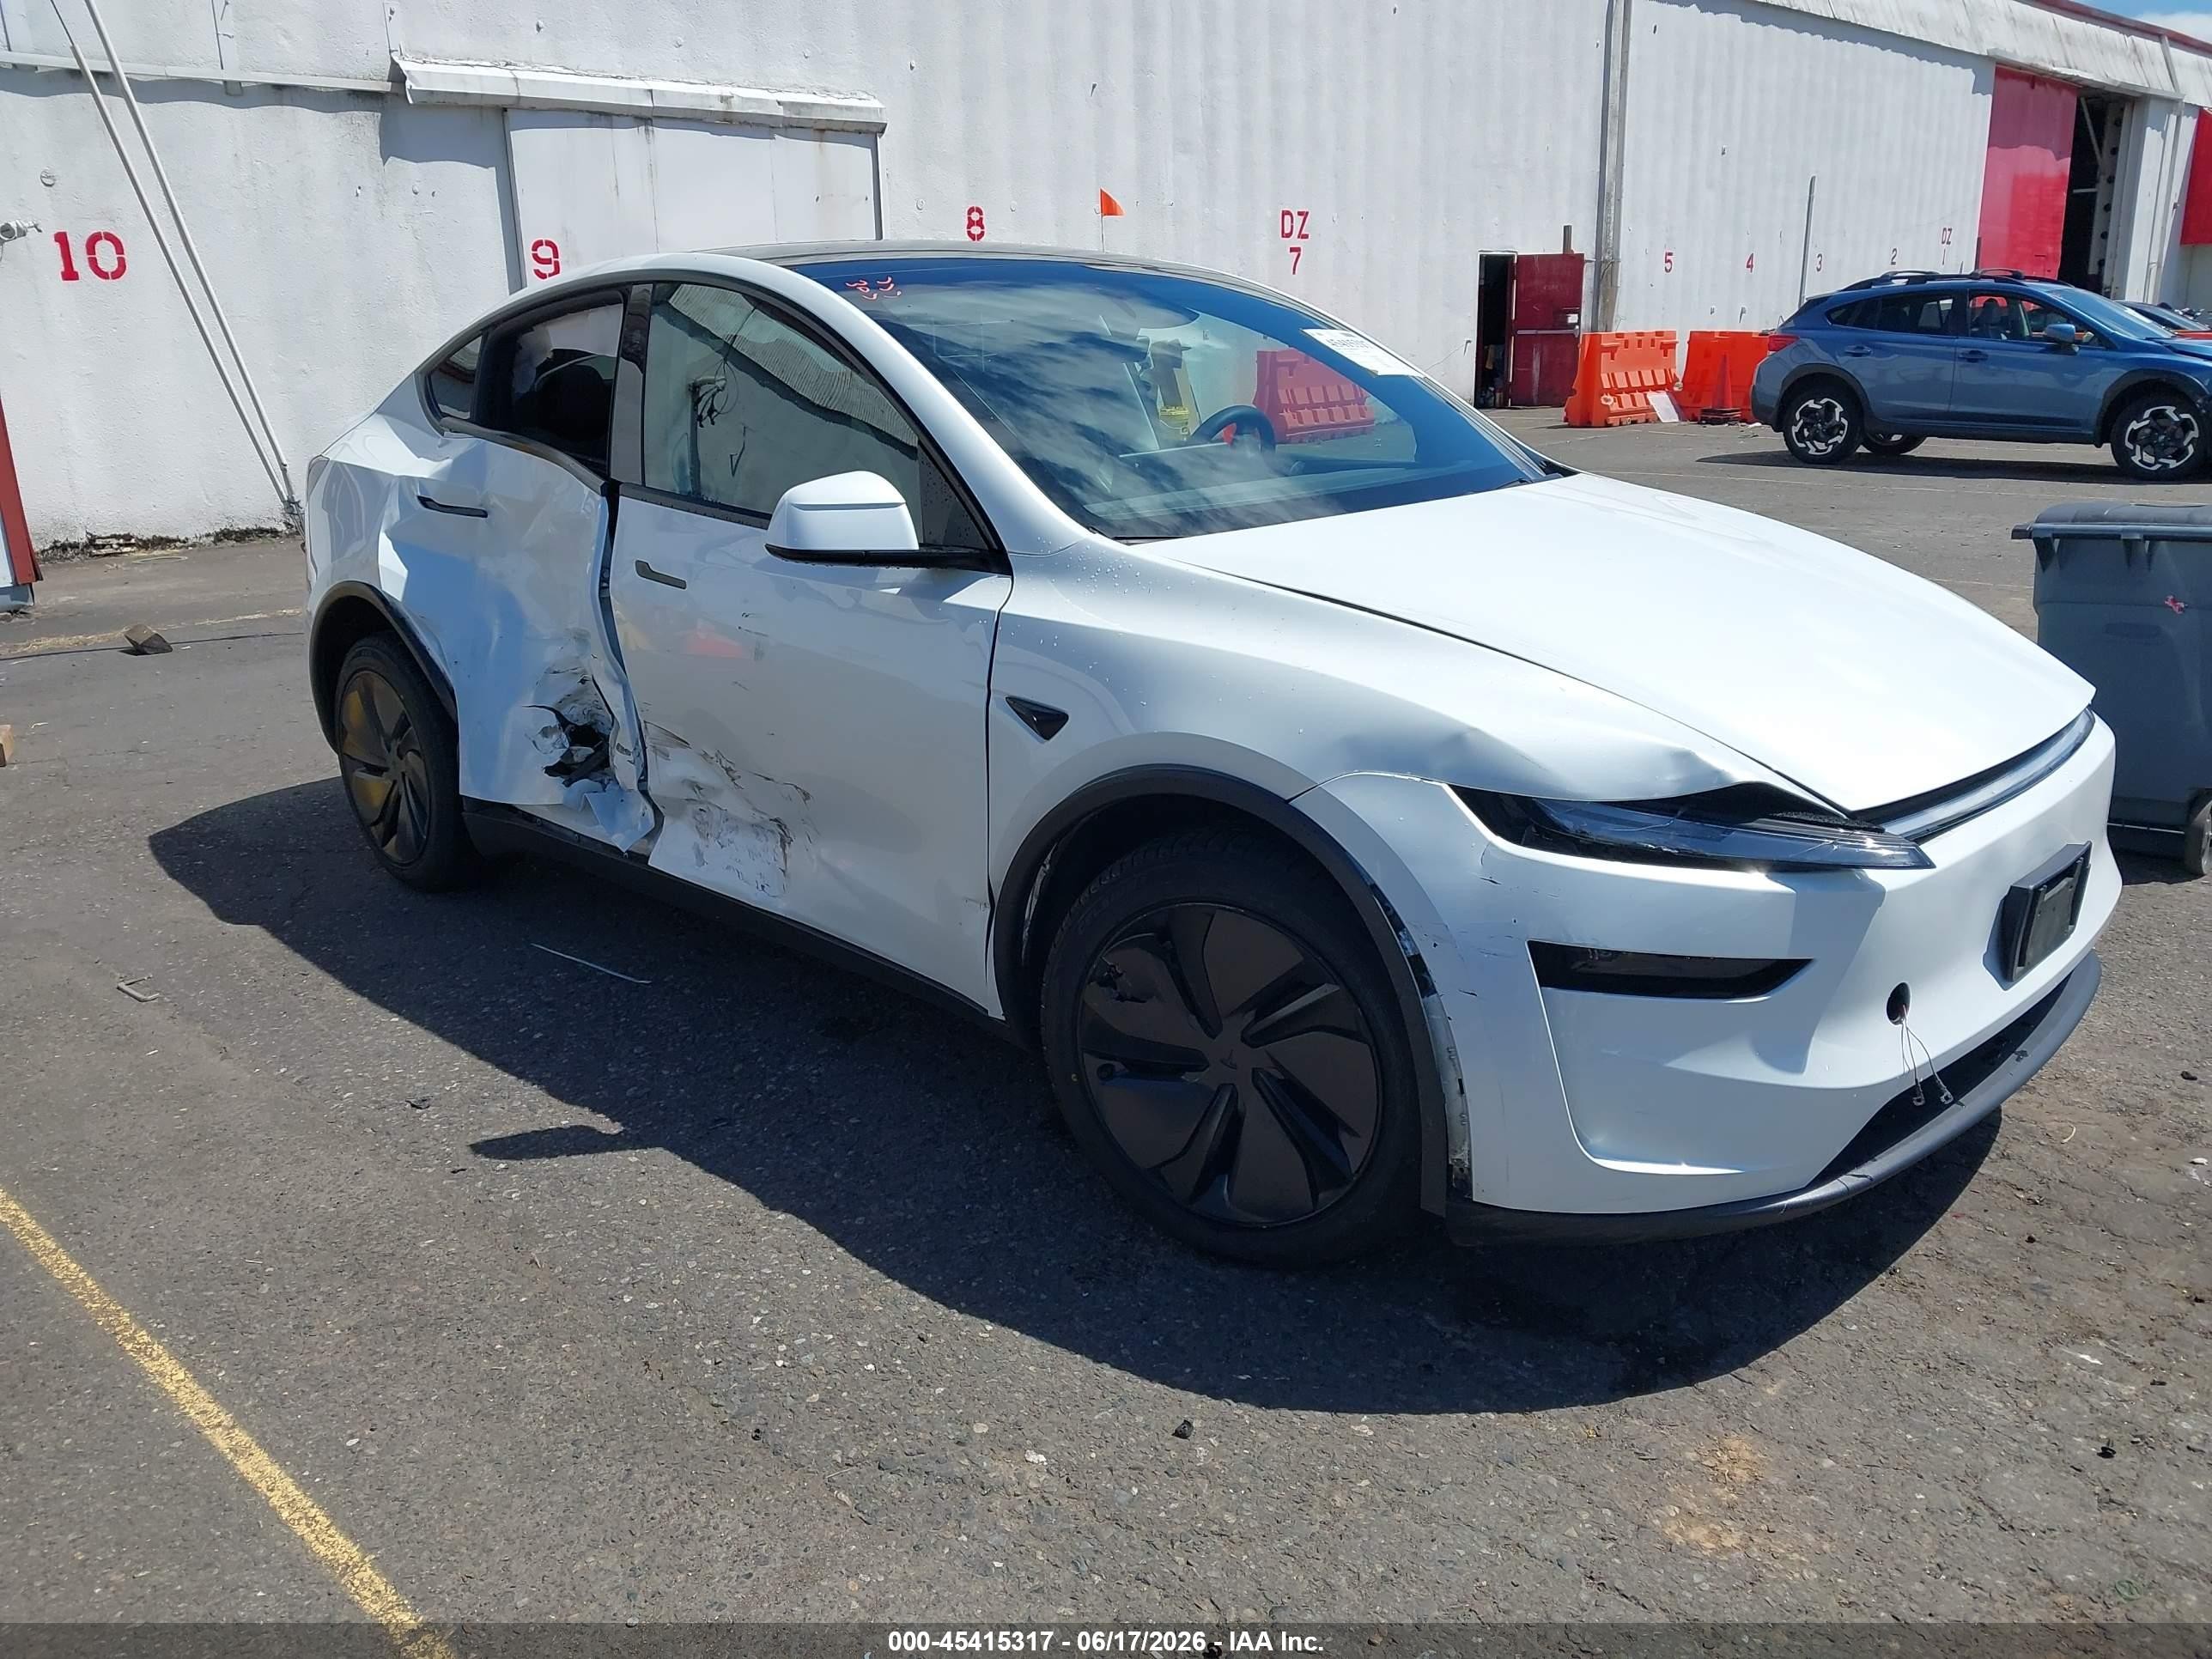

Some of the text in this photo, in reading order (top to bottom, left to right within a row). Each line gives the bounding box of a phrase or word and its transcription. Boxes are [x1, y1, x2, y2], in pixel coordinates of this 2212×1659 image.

[966, 205, 986, 242] 8
[1280, 210, 1310, 240] DZ
[53, 230, 128, 282] 10
[531, 239, 561, 280] 9
[1289, 246, 1303, 276] 7
[1664, 252, 1674, 274] 5
[1746, 252, 1755, 274] 4
[1816, 252, 1824, 272] 3
[1890, 247, 1898, 266] 2
